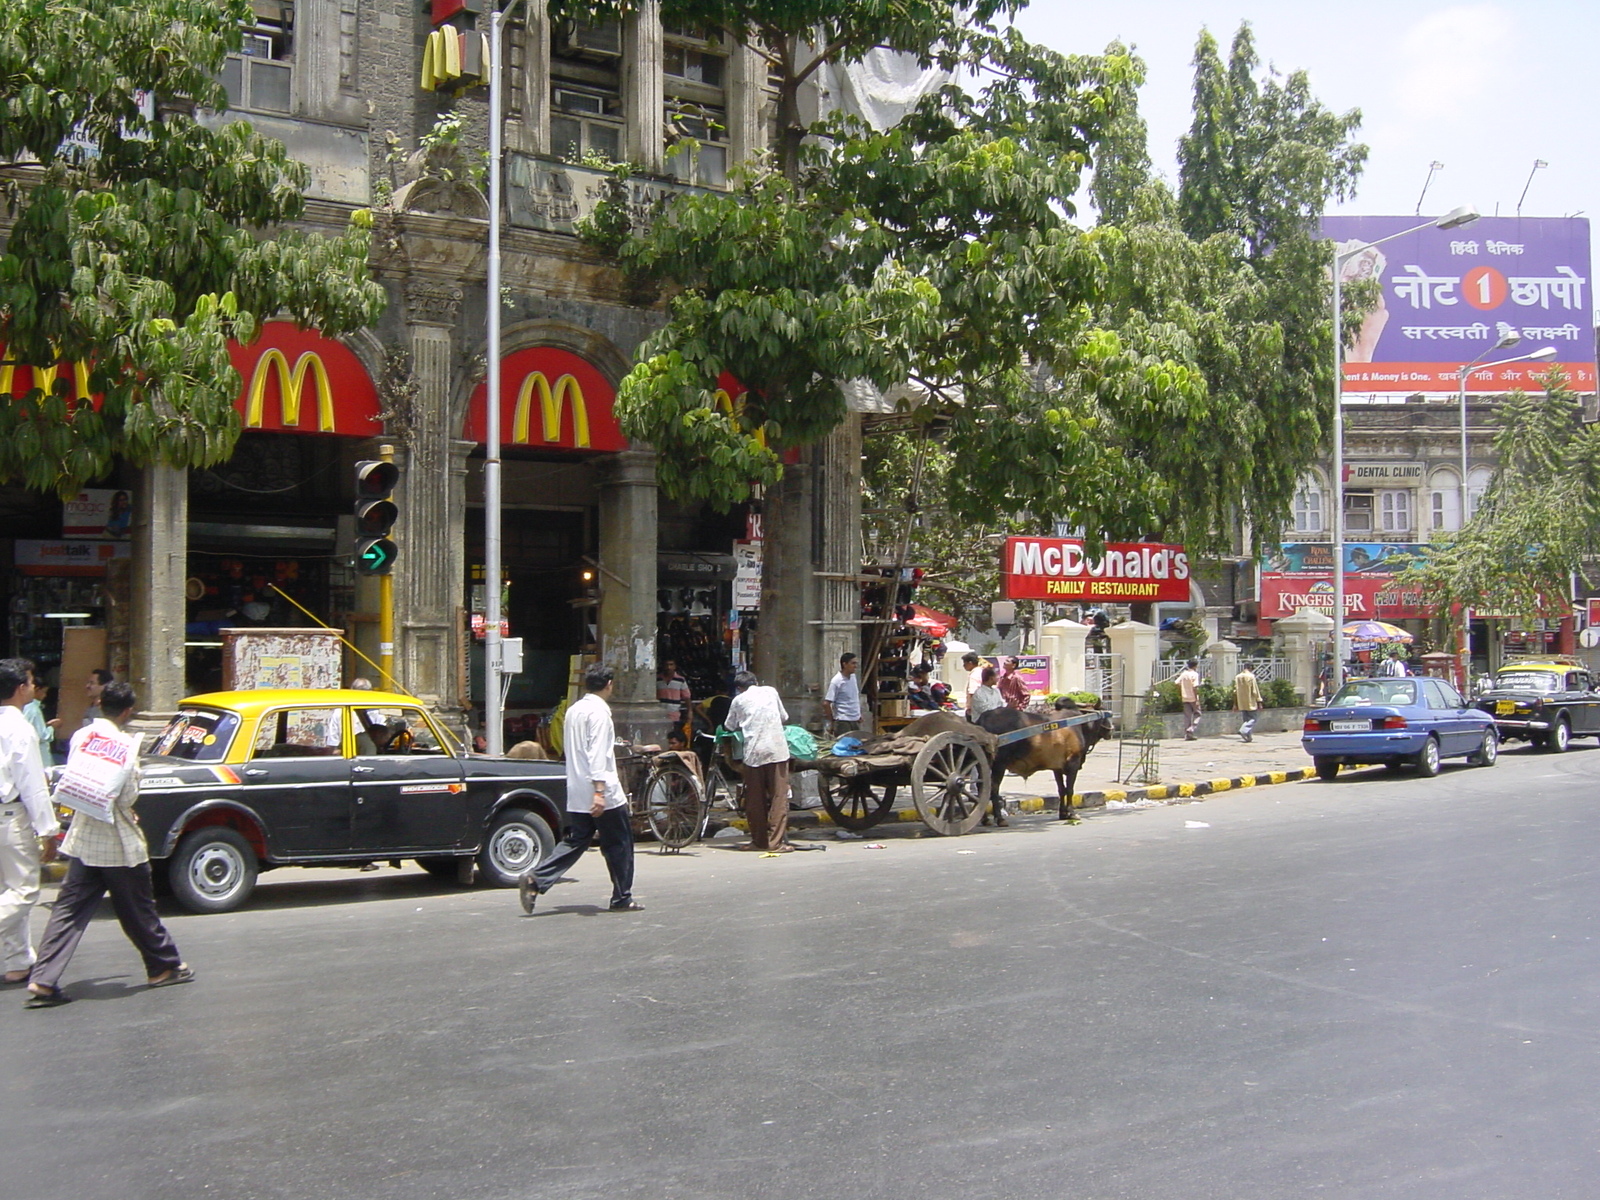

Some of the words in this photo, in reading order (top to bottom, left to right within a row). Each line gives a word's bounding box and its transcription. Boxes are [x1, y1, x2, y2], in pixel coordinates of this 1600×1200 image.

[1487, 239, 1524, 256] दैनिक
[1392, 265, 1460, 309] नोट
[1476, 273, 1489, 303] 1
[1508, 265, 1586, 310] छापो
[1402, 322, 1489, 340] सरस्वती
[1522, 322, 1580, 340] लक्ष्मी
[1371, 371, 1400, 383] Money
[1410, 371, 1432, 381] One.
[1357, 466, 1389, 478] DENTAL
[1392, 466, 1421, 478] CLINIC
[697, 563, 722, 573] SHOS
[1012, 541, 1189, 580] McDonald's
[1047, 580, 1085, 594] FAMILY
[1091, 581, 1160, 596] RESTAURANT
[1278, 592, 1366, 611] KINGFISER
